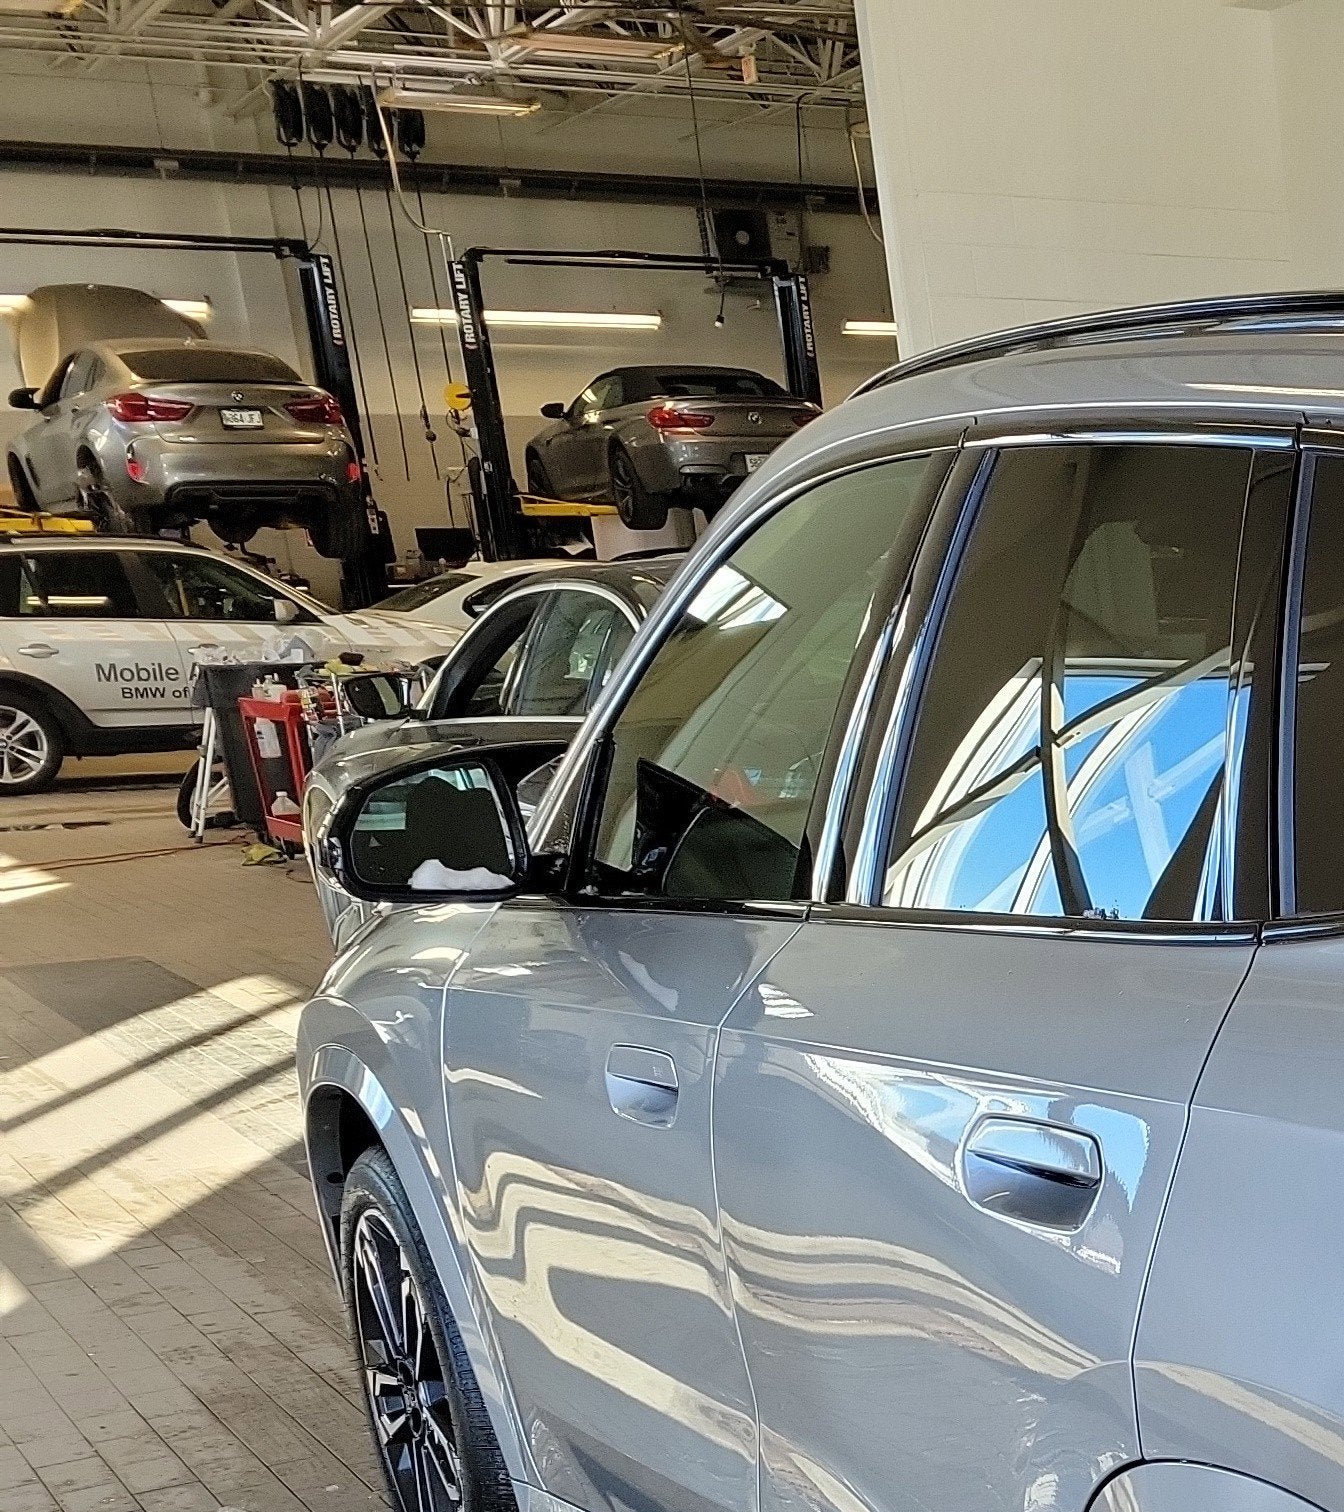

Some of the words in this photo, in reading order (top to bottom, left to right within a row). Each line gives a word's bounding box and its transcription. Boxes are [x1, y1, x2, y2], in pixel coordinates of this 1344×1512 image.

[452, 262, 467, 290] LIFT
[325, 286, 342, 338] ROTARY
[457, 292, 476, 343] ROTARY
[95, 662, 180, 682] Mobile
[121, 686, 166, 699] BMW
[172, 686, 189, 699] of
